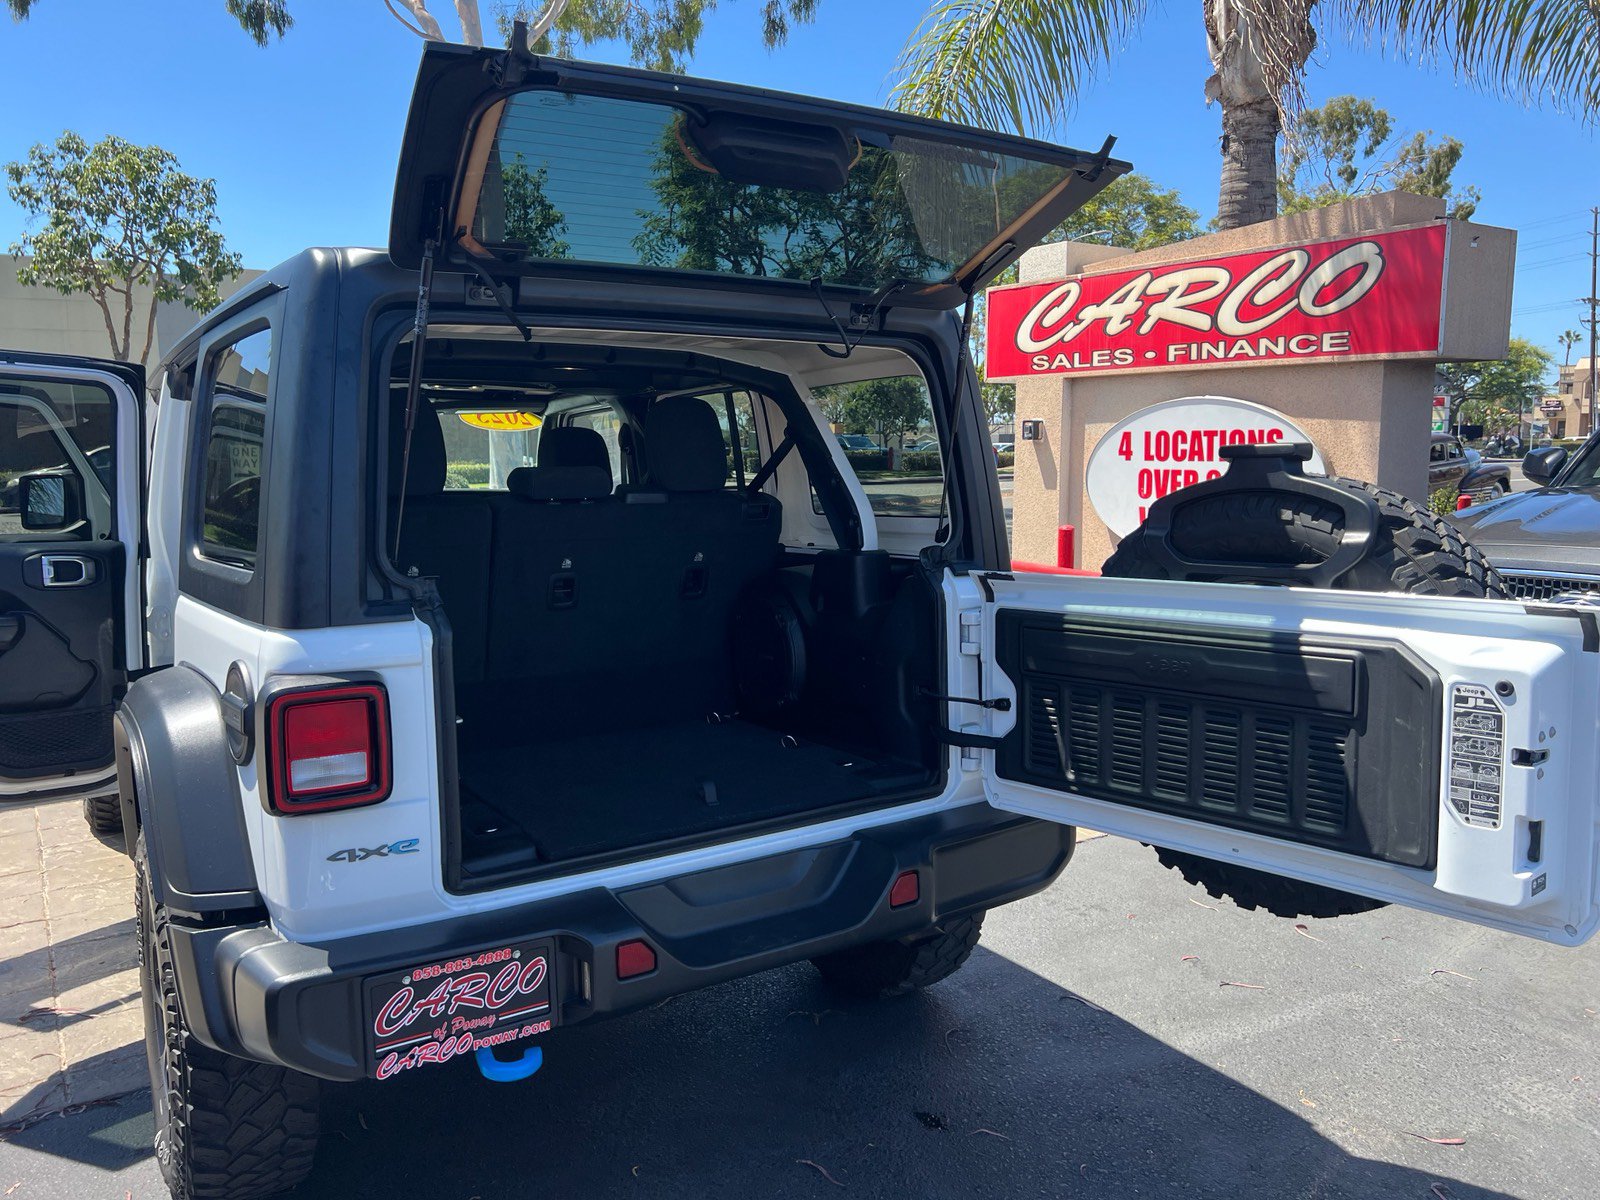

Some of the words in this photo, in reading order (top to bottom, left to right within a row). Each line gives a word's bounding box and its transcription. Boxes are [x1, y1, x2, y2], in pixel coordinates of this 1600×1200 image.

[1015, 241, 1386, 354] CARCO
[1031, 347, 1134, 371] SALES
[1166, 331, 1351, 362] FINANCE
[232, 447, 258, 458] ONE
[1118, 431, 1133, 461] 4
[233, 459, 259, 469] WAY
[1472, 793, 1496, 803] USA
[412, 948, 512, 982] 858-883-4888
[374, 956, 548, 1037] CARCO
[432, 1021, 448, 1041] of
[451, 1013, 497, 1036] Poway
